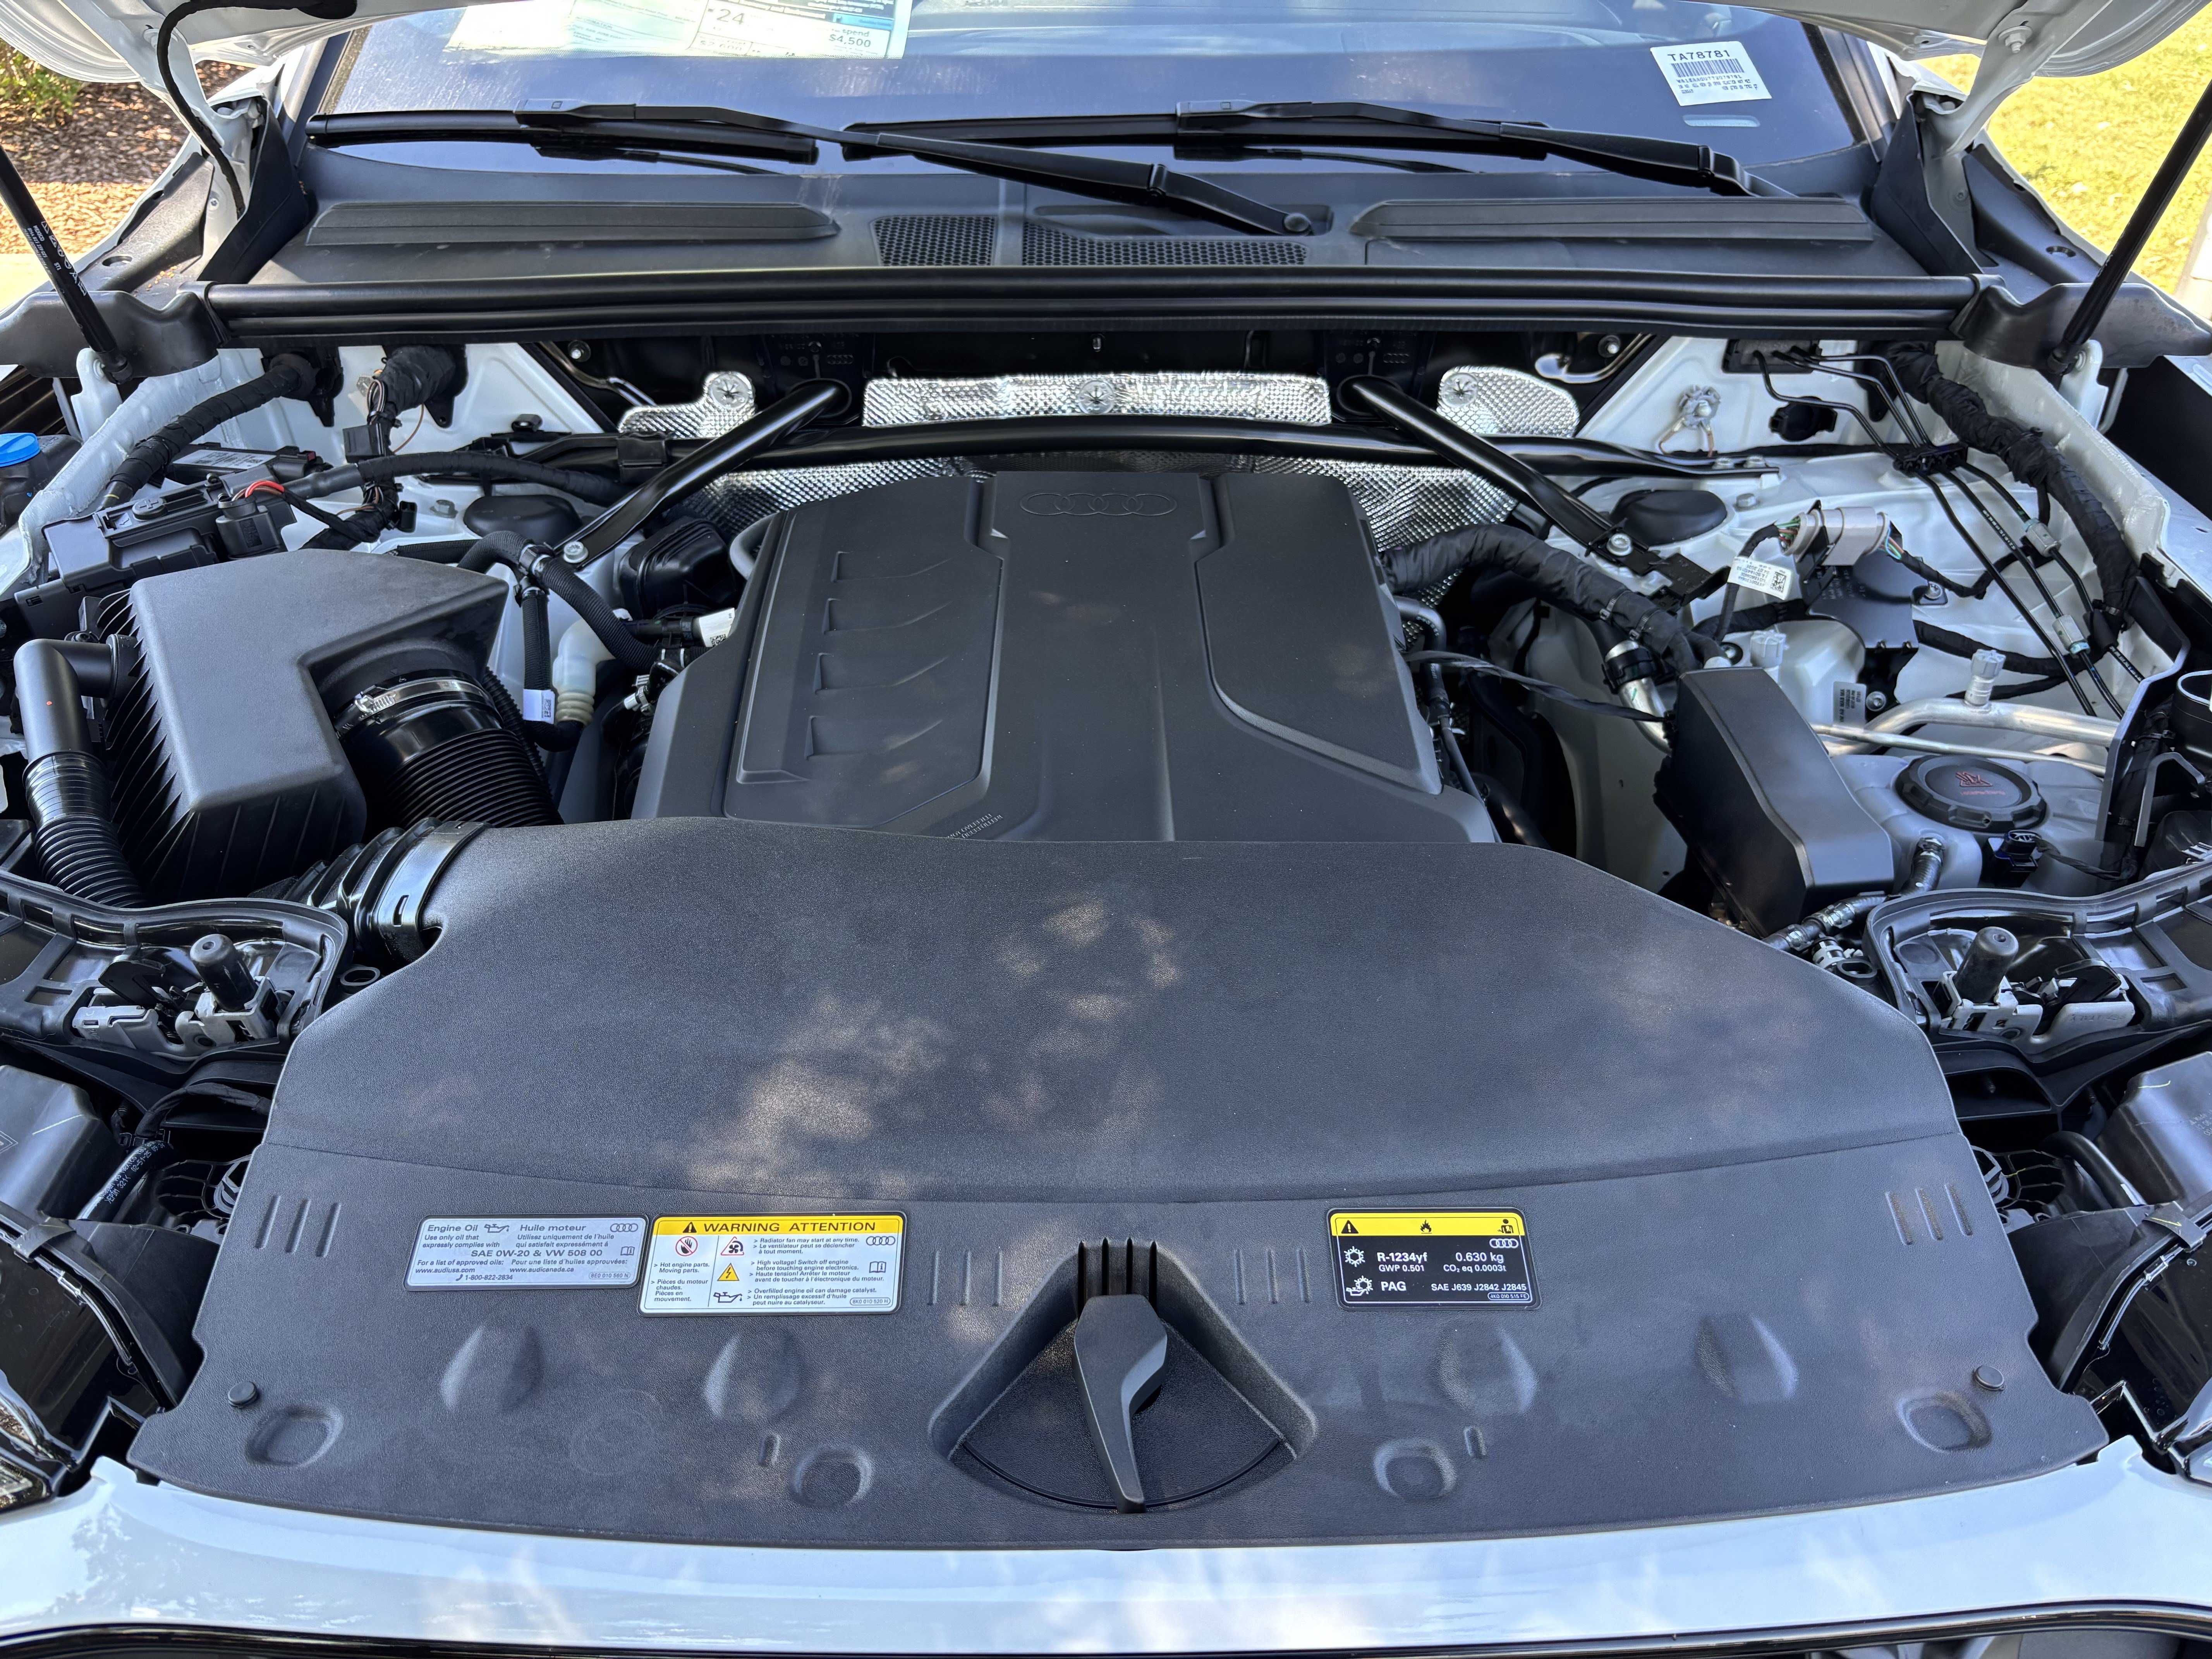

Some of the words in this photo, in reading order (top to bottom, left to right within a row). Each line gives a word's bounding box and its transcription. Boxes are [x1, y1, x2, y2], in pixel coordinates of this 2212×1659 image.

[829, 34, 871, 47] $4,500
[1667, 50, 1731, 61] TA78781
[428, 1224, 461, 1233] Engine
[703, 1222, 780, 1232] WARNING
[788, 1221, 876, 1231] ATTENTION
[1377, 1252, 1427, 1263] R-1234yf
[1455, 1252, 1487, 1262] 0.630
[1490, 1252, 1504, 1264] kg
[1381, 1281, 1407, 1291] PAG
